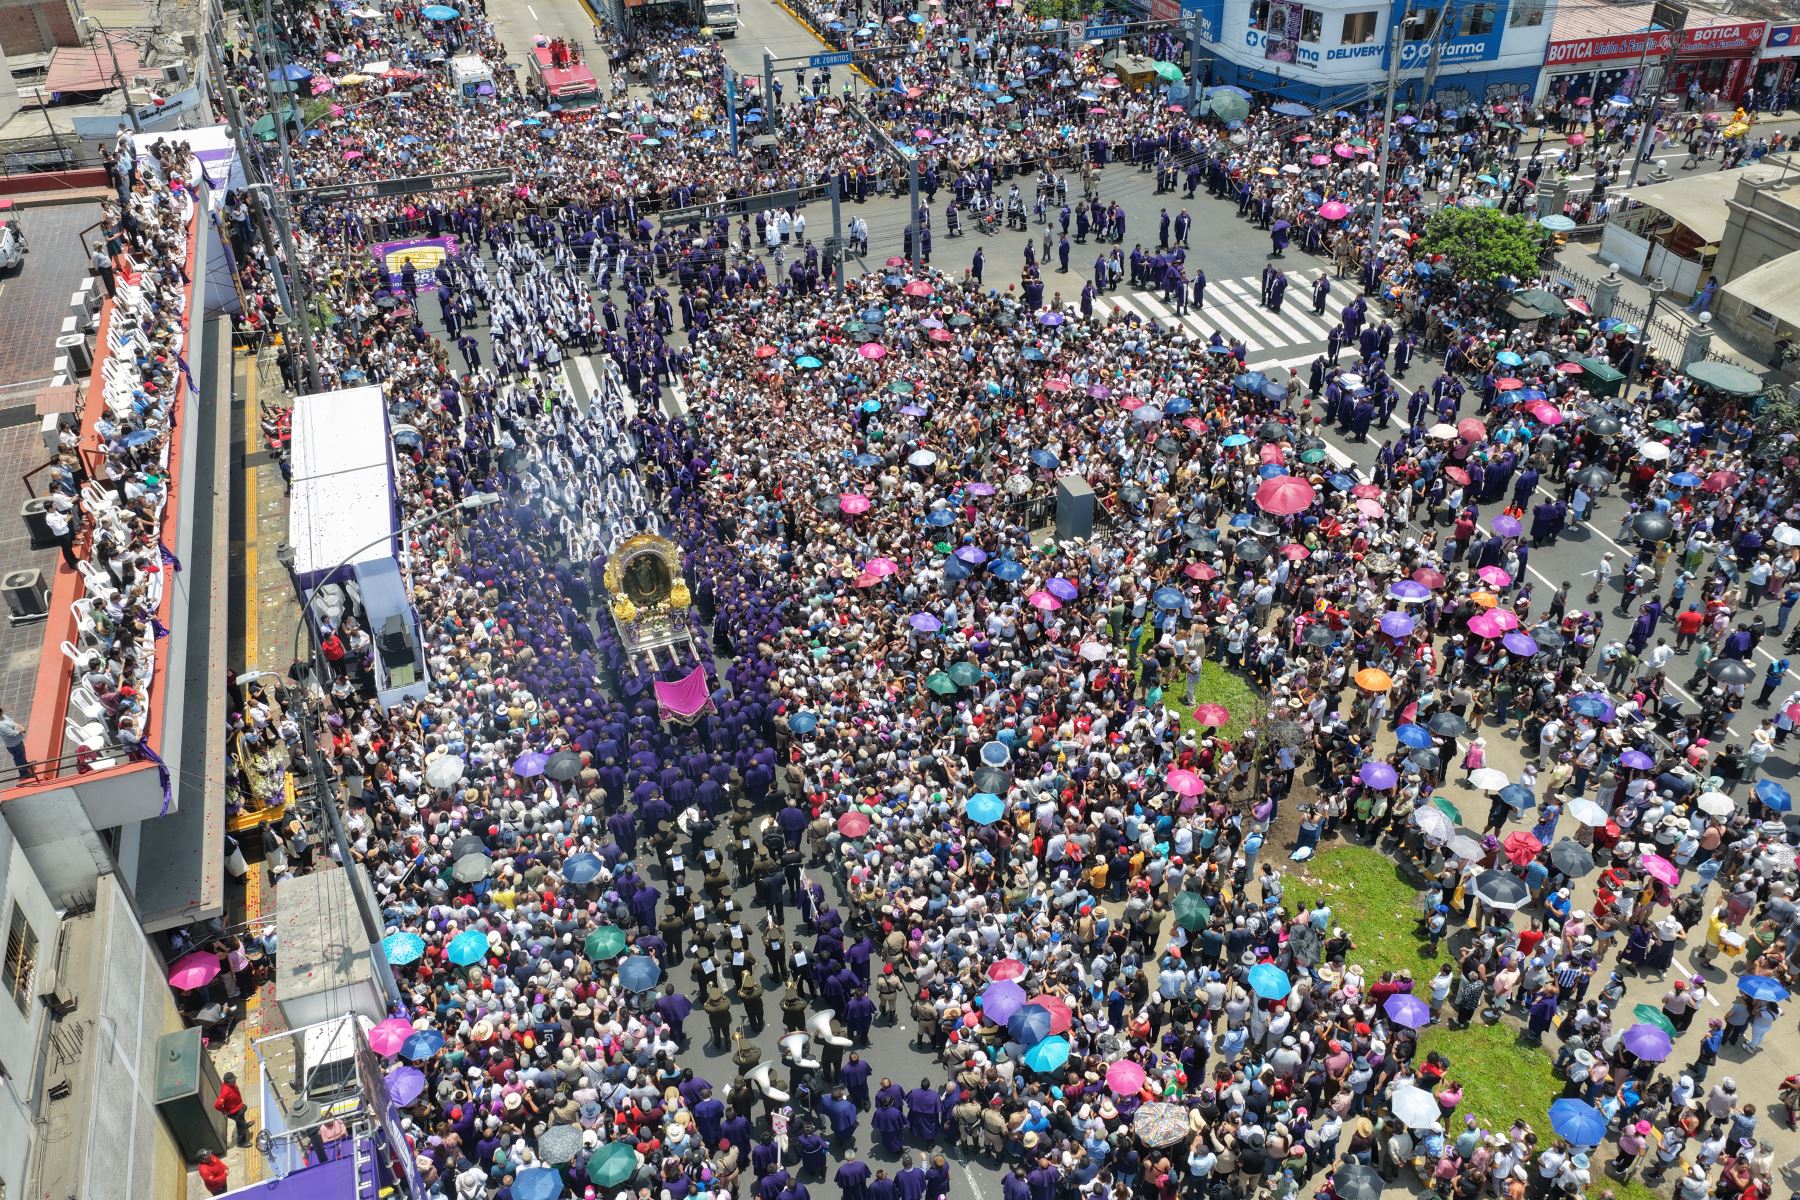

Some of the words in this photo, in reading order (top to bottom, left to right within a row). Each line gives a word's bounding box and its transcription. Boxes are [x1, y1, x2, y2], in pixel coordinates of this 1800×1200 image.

[1097, 27, 1122, 37] ZORRITOS
[1694, 27, 1740, 41] BOTICA
[1708, 41, 1716, 50] &
[1718, 38, 1748, 50] Familia
[1326, 44, 1384, 60] DELIVERY
[1548, 41, 1592, 62] BOTICA
[1594, 41, 1619, 55] Unión
[1619, 42, 1627, 53] &
[813, 57, 822, 65] JR.
[822, 54, 849, 64] ZORRITOS
[544, 1033, 554, 1043] 51
